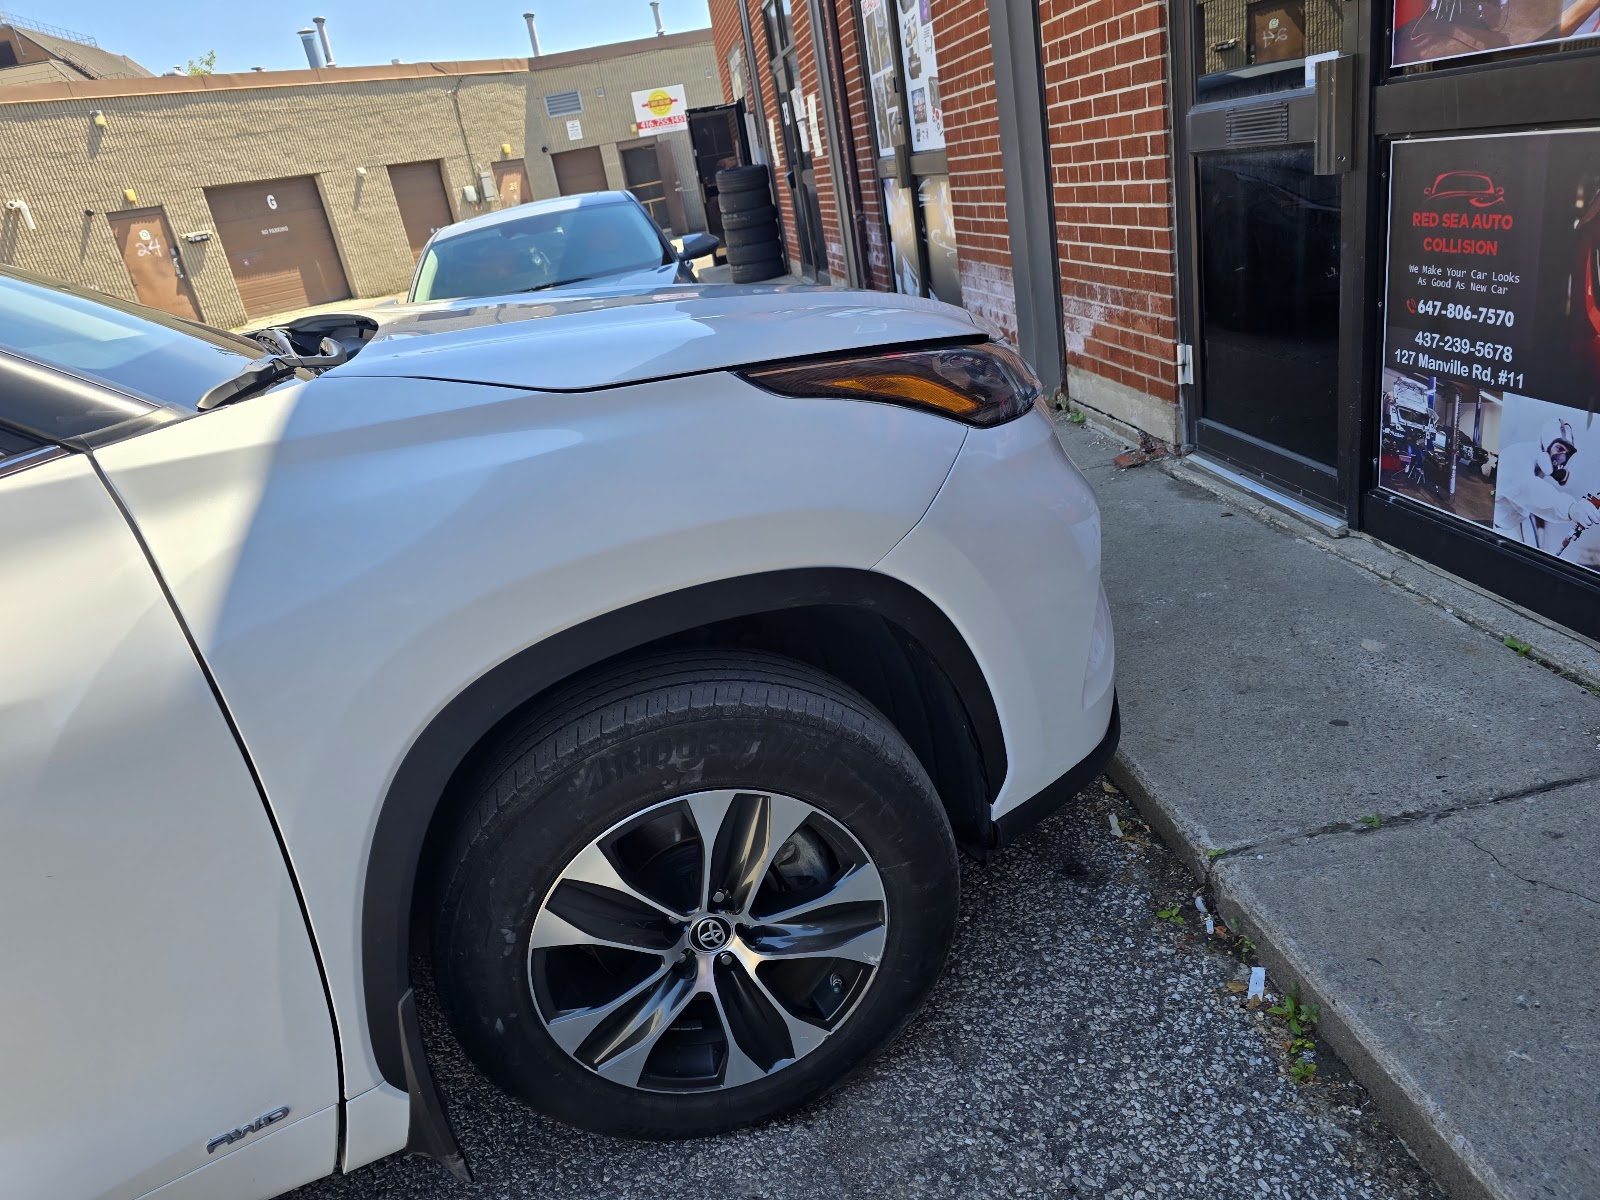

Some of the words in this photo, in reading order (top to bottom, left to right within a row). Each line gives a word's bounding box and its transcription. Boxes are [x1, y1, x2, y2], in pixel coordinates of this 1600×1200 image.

[269, 226, 289, 234] PARKING
[1412, 212, 1439, 226] RED
[1442, 213, 1469, 228] SEA
[1472, 214, 1514, 230] AUTO
[135, 239, 162, 257] 24
[1423, 237, 1498, 255] COLLISION
[1409, 264, 1419, 273] We
[1422, 265, 1442, 276] Make
[1446, 267, 1466, 278] Your
[1470, 269, 1488, 280] Car
[1492, 272, 1520, 284] Looks
[1417, 276, 1427, 286] As
[1431, 278, 1452, 289] Good
[1455, 281, 1465, 290] As
[1470, 282, 1487, 293] New
[1491, 284, 1509, 295] Car
[1417, 299, 1515, 327] 647-806-7570
[1414, 331, 1513, 362] 437-239-5678
[1394, 349, 1416, 366] 127
[1418, 352, 1469, 377] Manville
[1472, 364, 1495, 386] Rd,
[1498, 369, 1524, 389] #11
[206, 1106, 290, 1154] AWD
